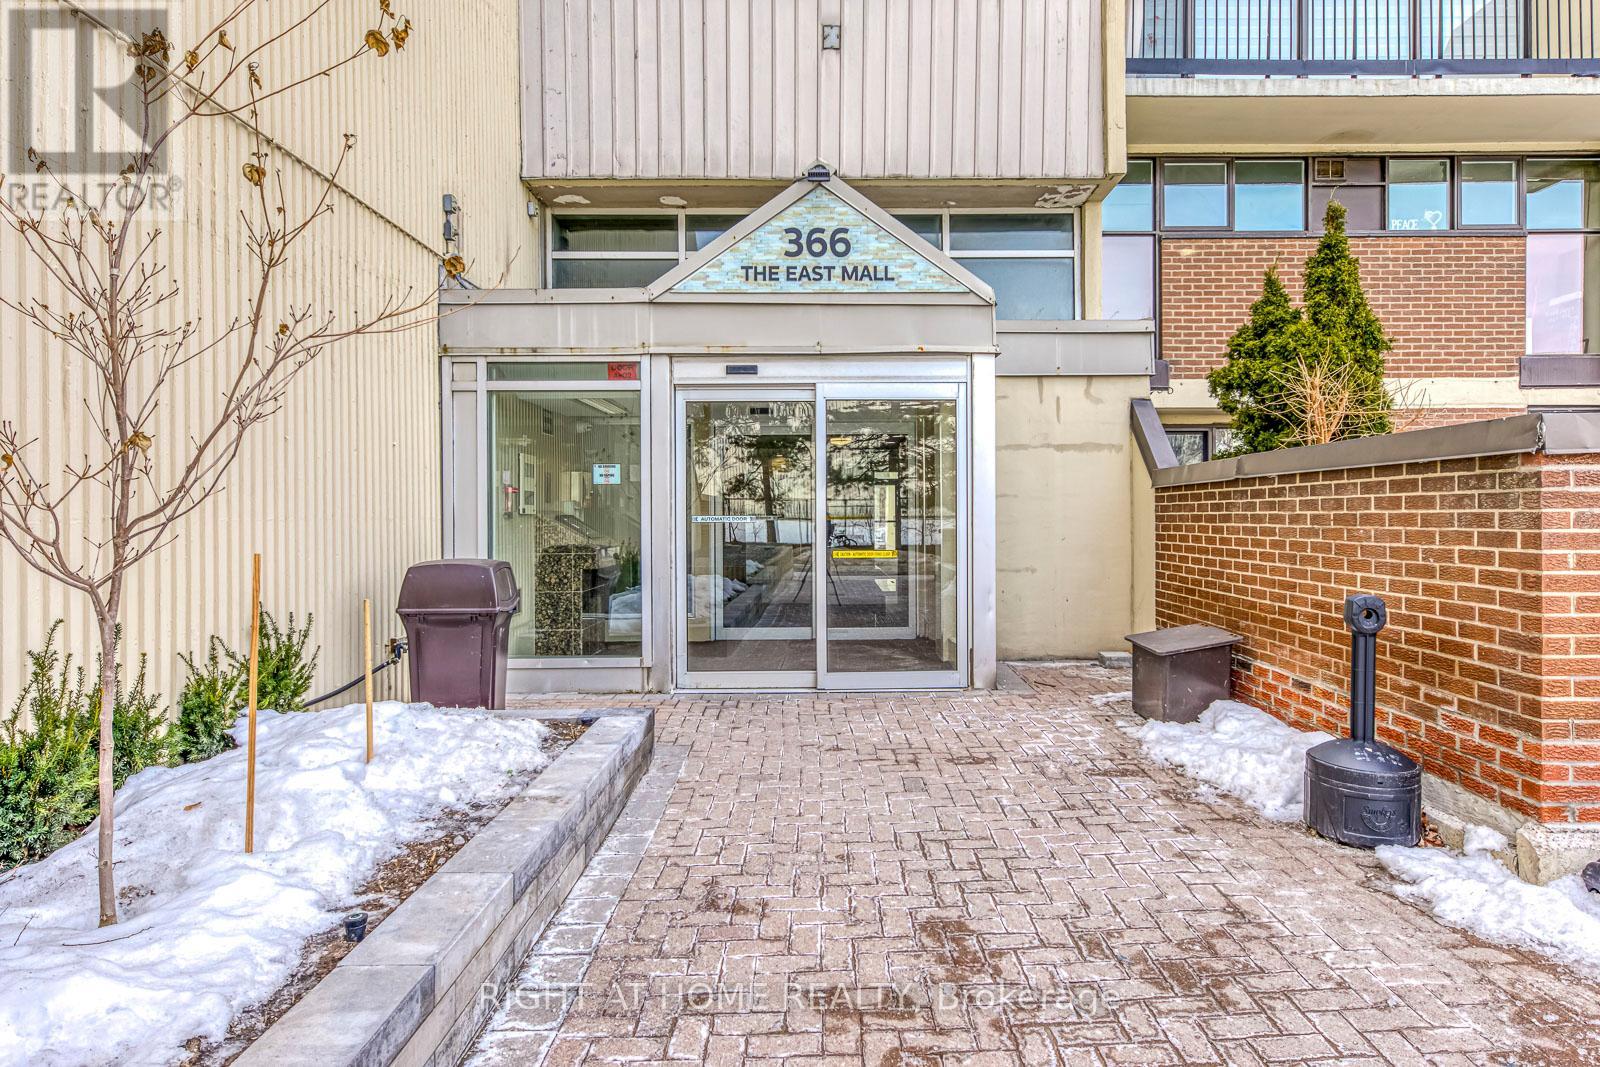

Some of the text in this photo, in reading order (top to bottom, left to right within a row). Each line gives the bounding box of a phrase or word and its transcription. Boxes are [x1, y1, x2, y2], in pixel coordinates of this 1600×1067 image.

[1391, 219, 1419, 230] PEACE
[783, 227, 851, 258] 366
[740, 265, 895, 282] THE EAST MALL
